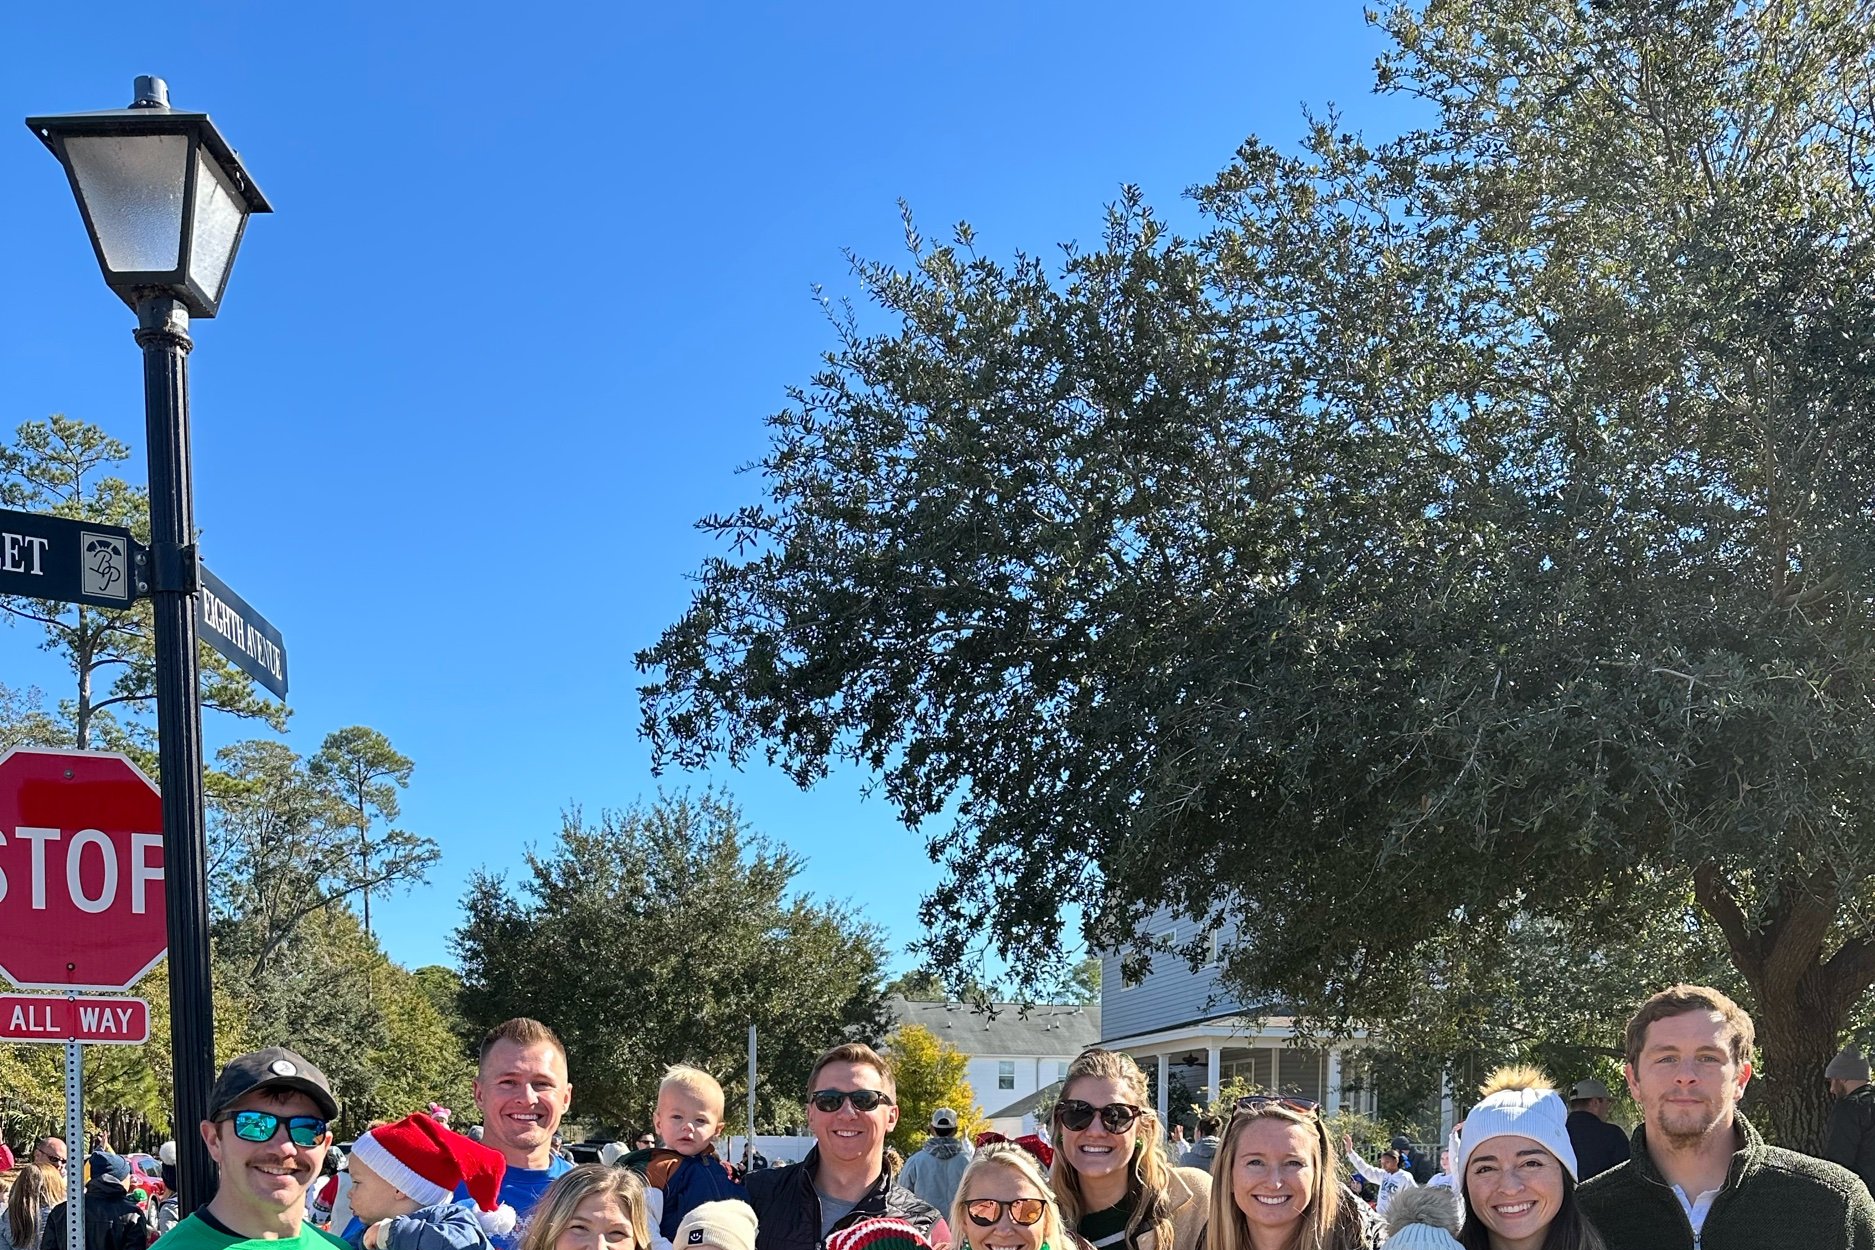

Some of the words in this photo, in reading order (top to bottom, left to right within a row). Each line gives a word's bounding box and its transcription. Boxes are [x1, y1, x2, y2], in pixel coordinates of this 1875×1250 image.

[0, 532, 49, 576] ET
[202, 587, 246, 652] EIGHTH
[247, 623, 283, 681] AVENUE
[0, 826, 165, 914] TOP
[9, 1004, 61, 1032] ALL
[79, 1006, 133, 1034] WAY
